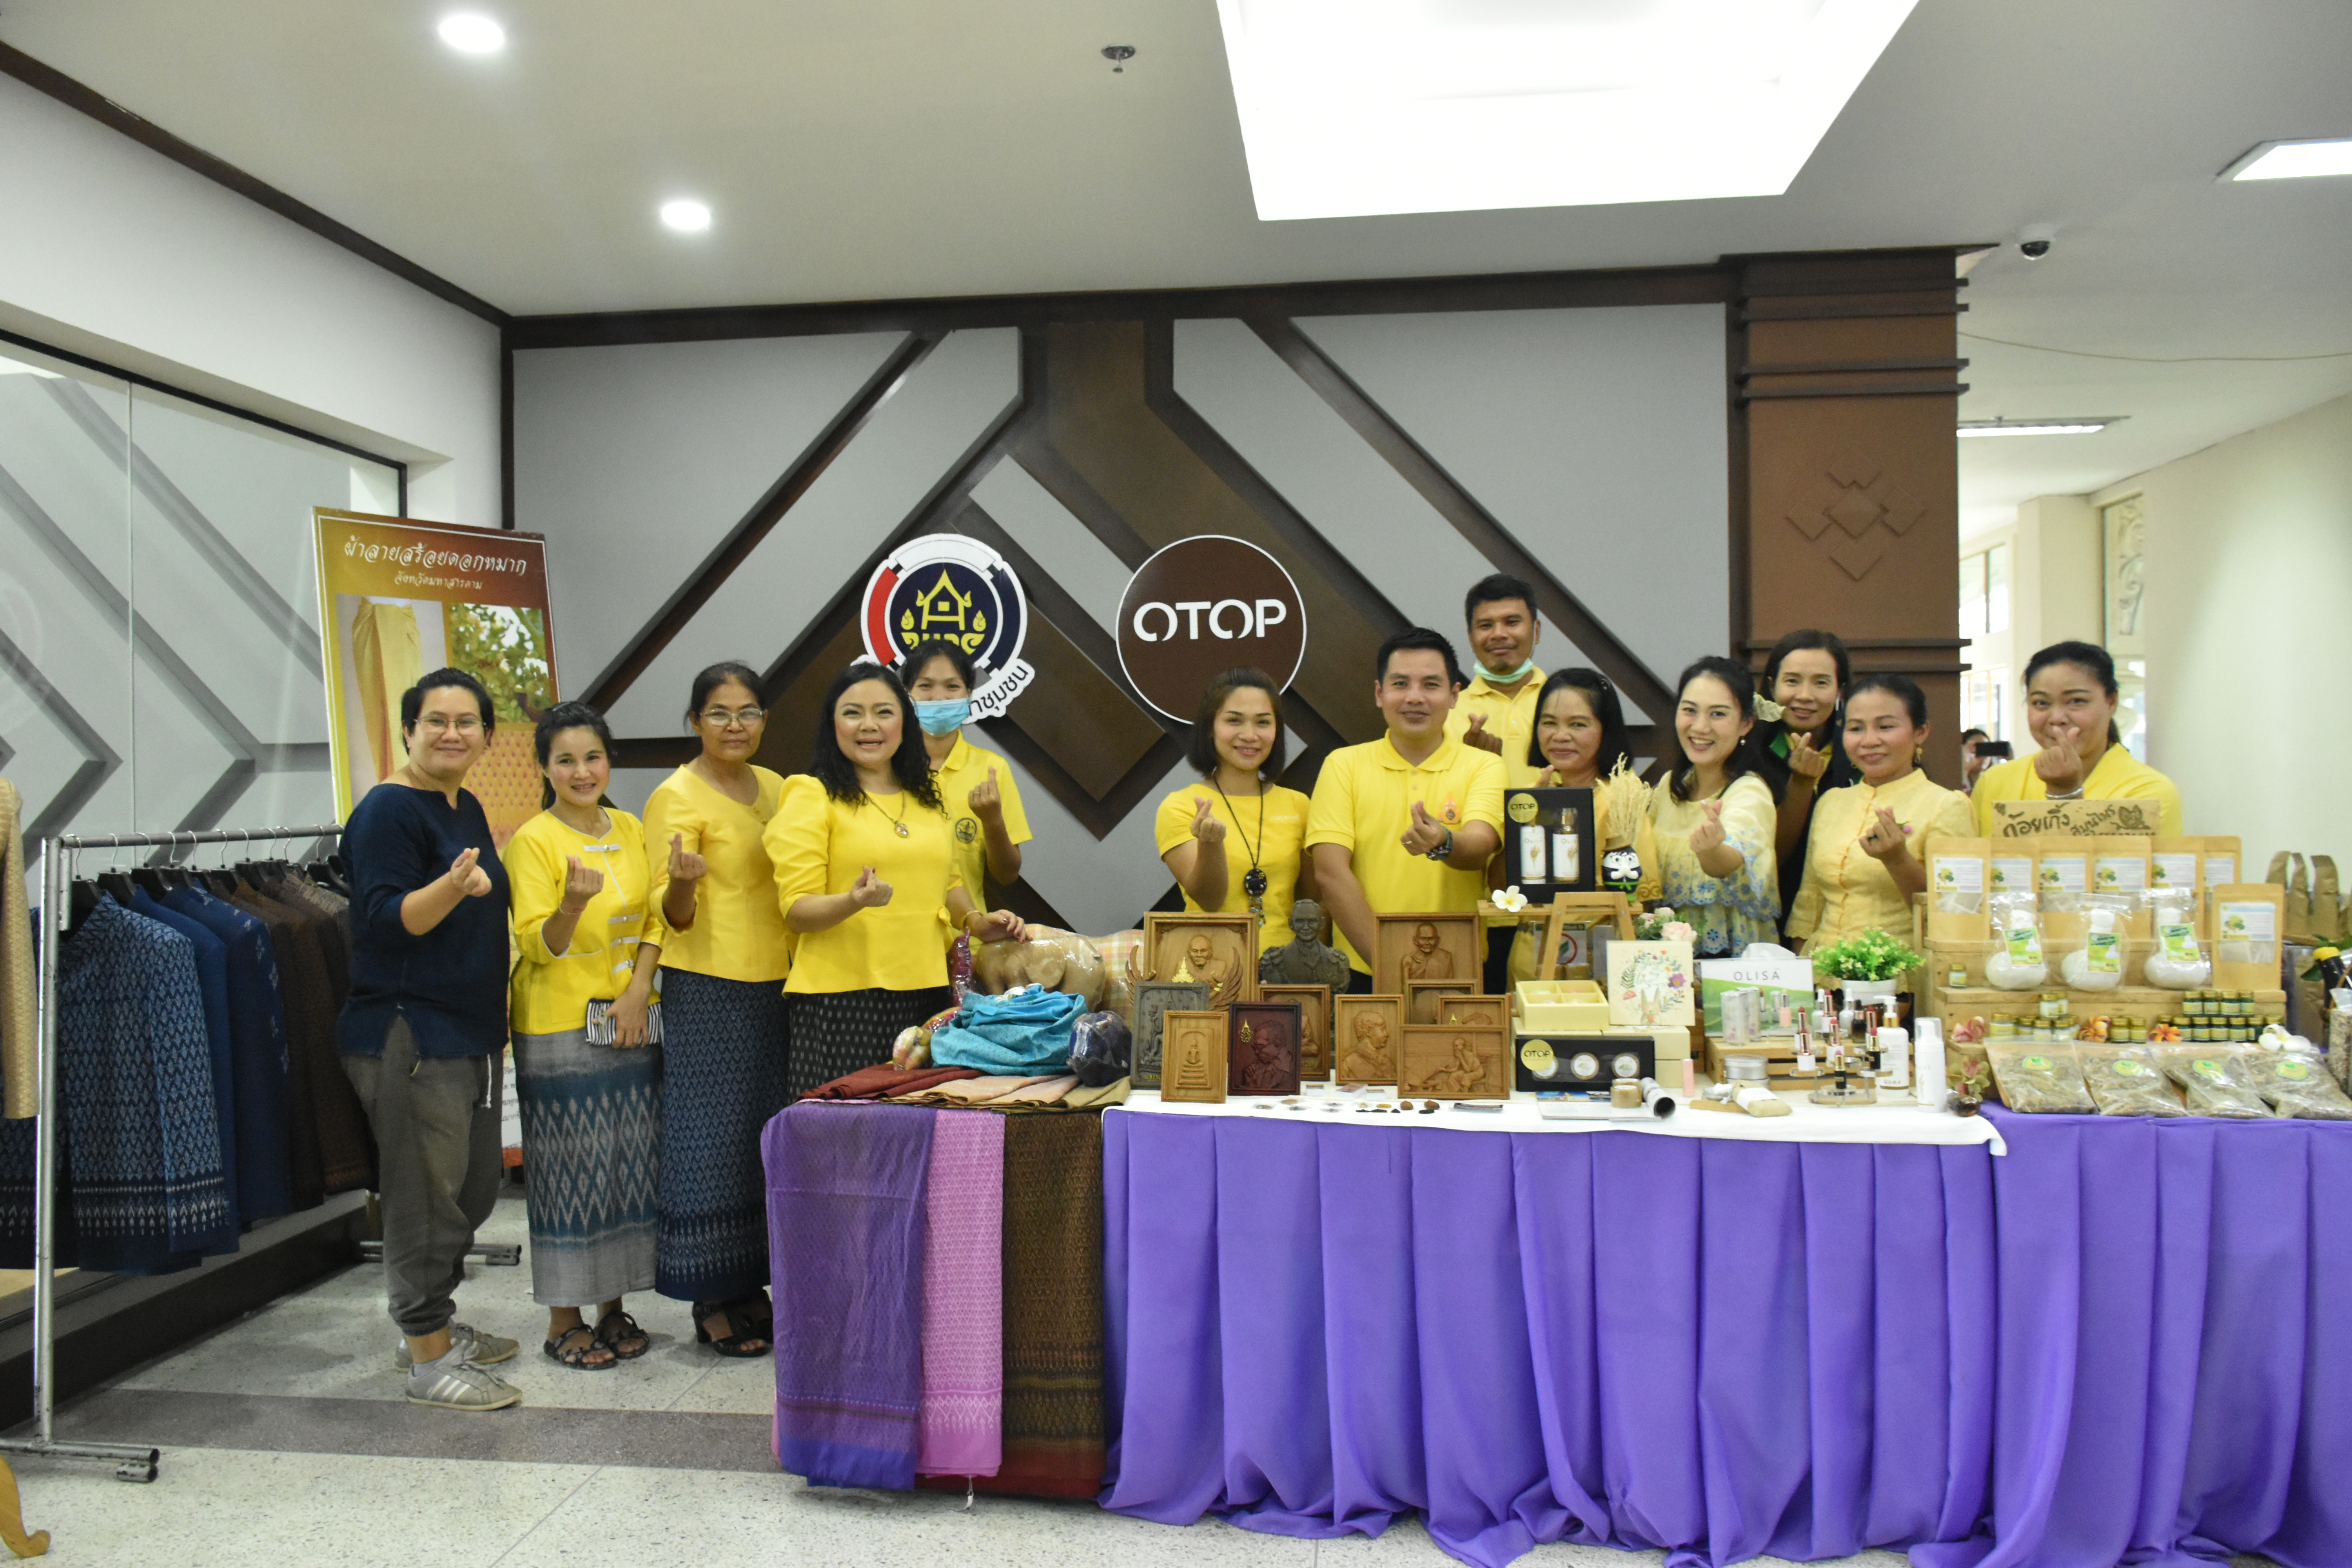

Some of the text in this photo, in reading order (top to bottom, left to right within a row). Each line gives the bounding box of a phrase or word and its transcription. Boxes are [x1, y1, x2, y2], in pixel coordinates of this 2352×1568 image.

[344, 535, 527, 576] ผ้าลายสร้อยดอกหมาก
[395, 570, 483, 590] จังหวัดมหาสารคาม
[1133, 599, 1287, 642] OTOP
